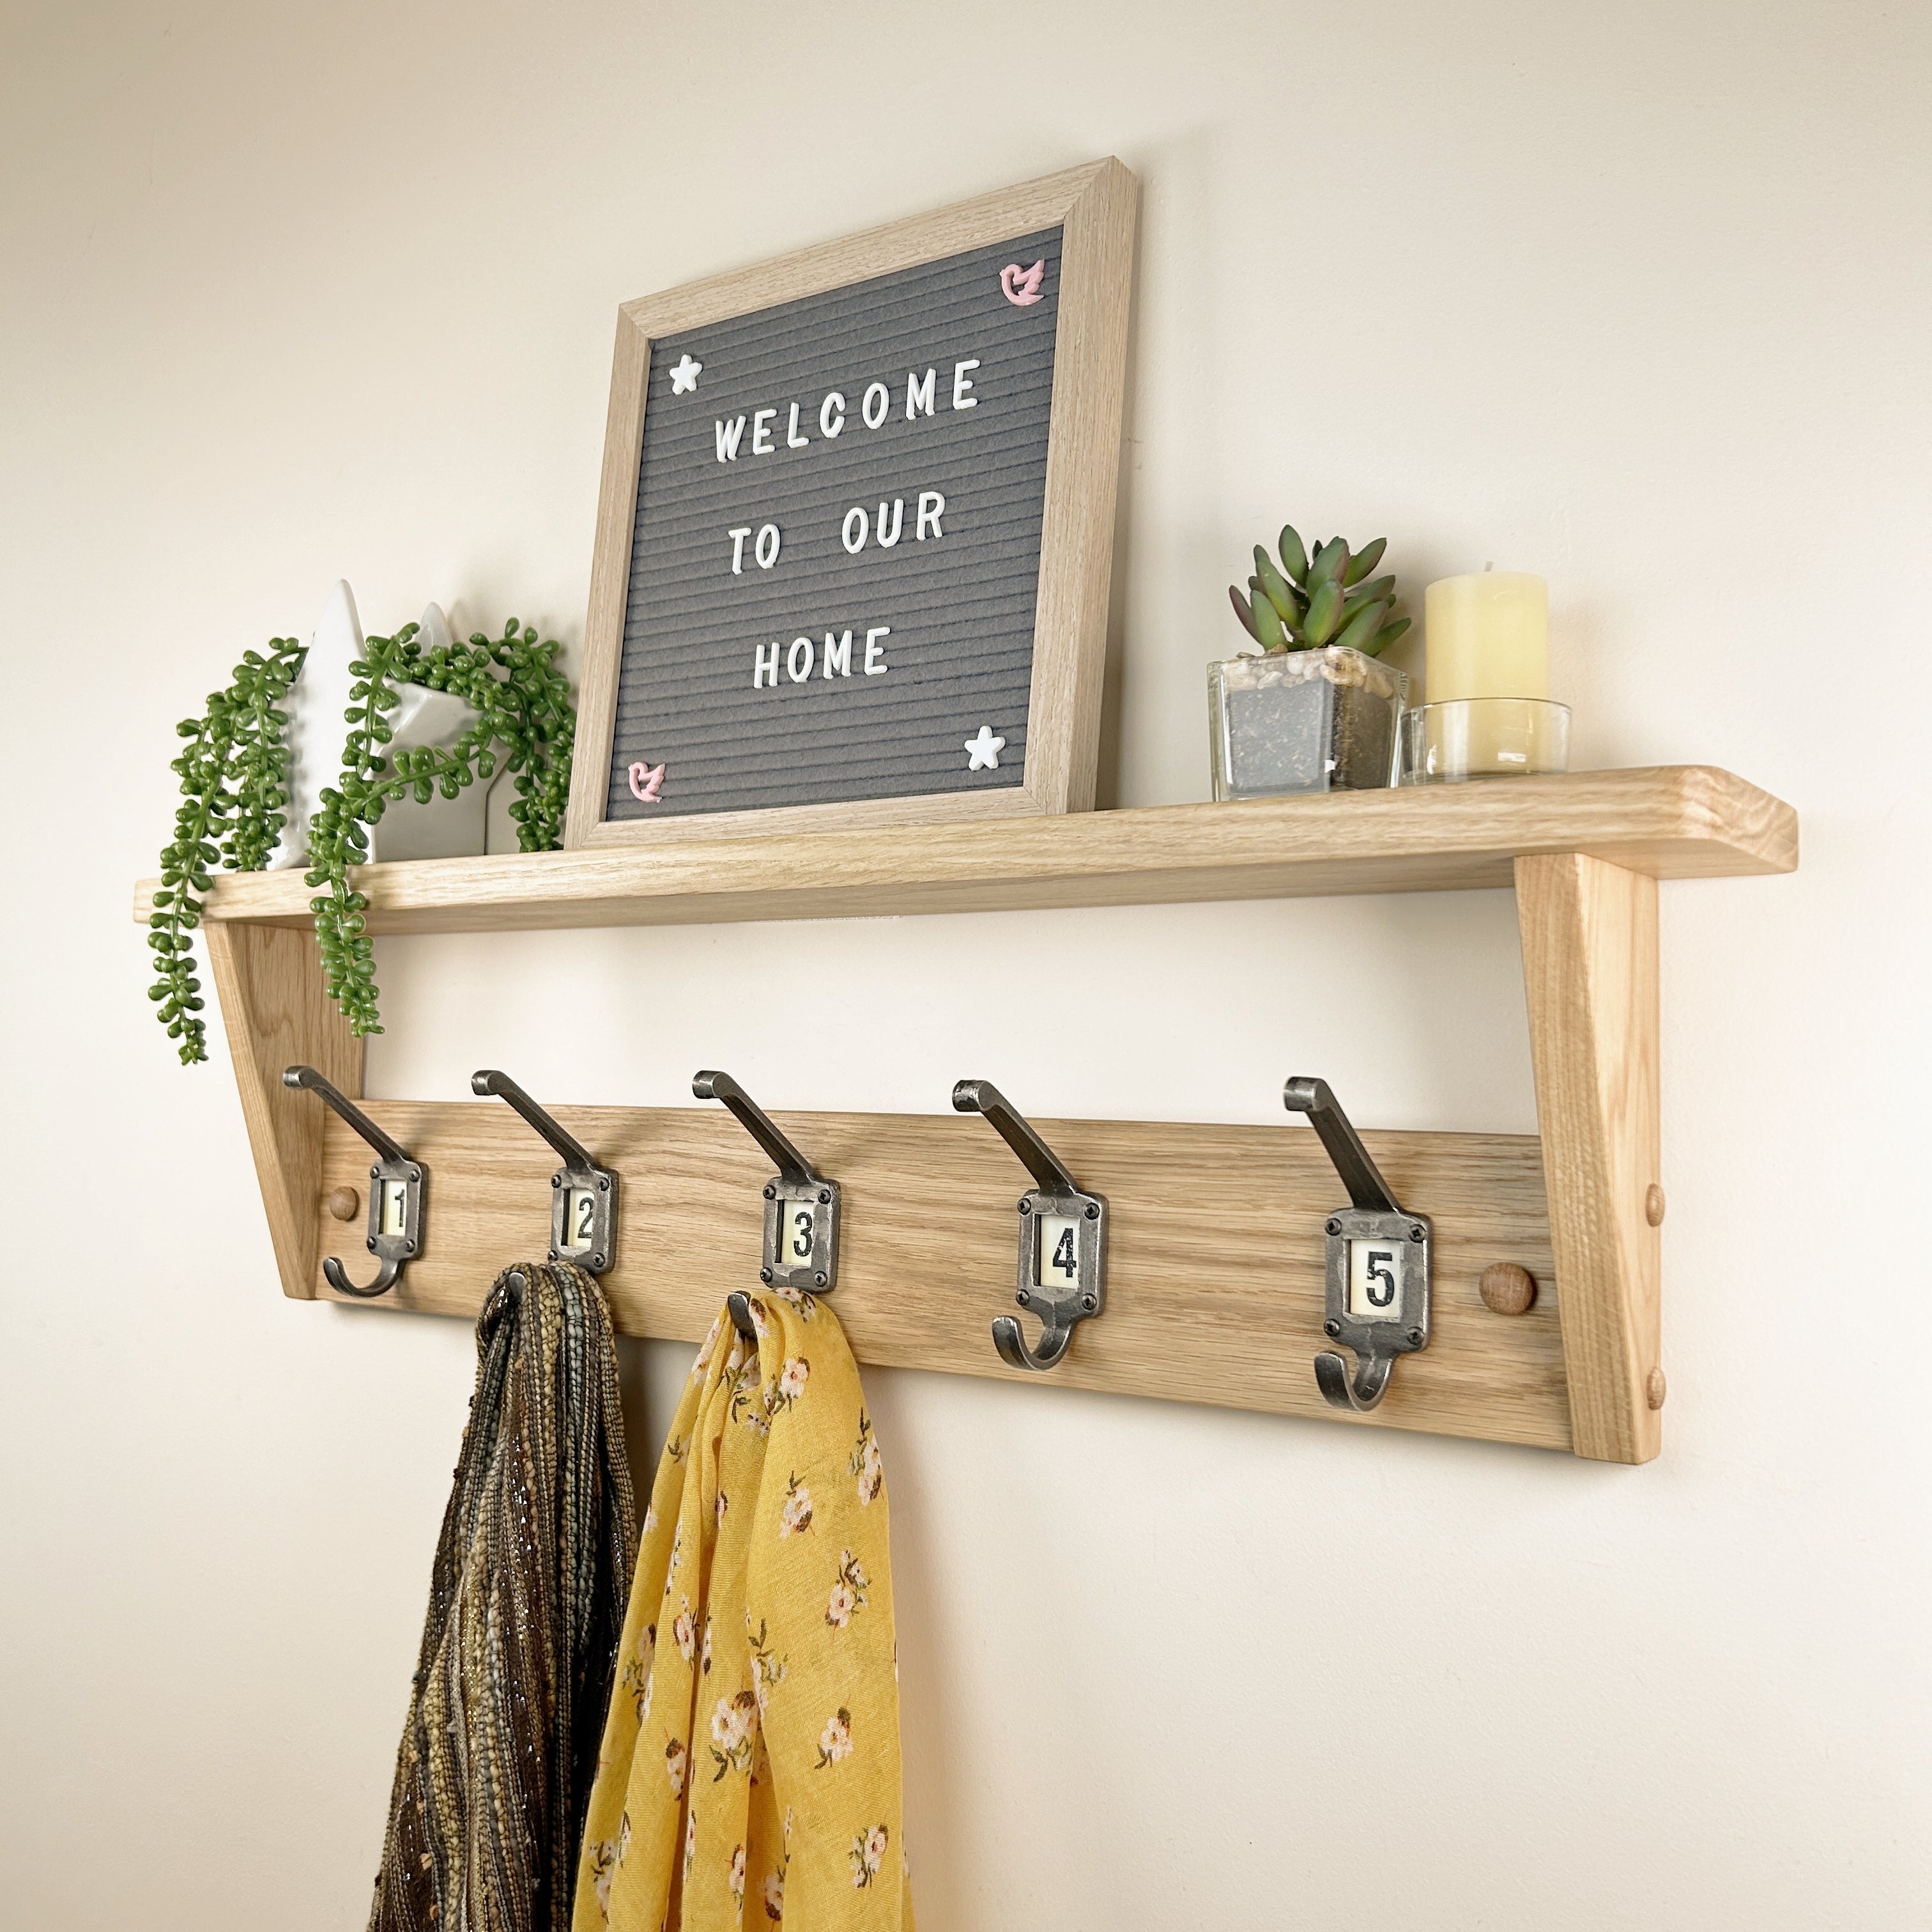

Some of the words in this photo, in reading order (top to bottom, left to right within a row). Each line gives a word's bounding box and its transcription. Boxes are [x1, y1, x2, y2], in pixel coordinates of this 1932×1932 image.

[714, 358, 981, 464] WELCOME
[727, 523, 781, 576] TO
[841, 490, 946, 555] OUR
[753, 625, 891, 689] HOME
[394, 1188, 405, 1227] 1
[577, 1196, 595, 1239] 2
[793, 1211, 813, 1257] 3
[1052, 1227, 1077, 1278] 4
[1365, 1251, 1395, 1307] 5
